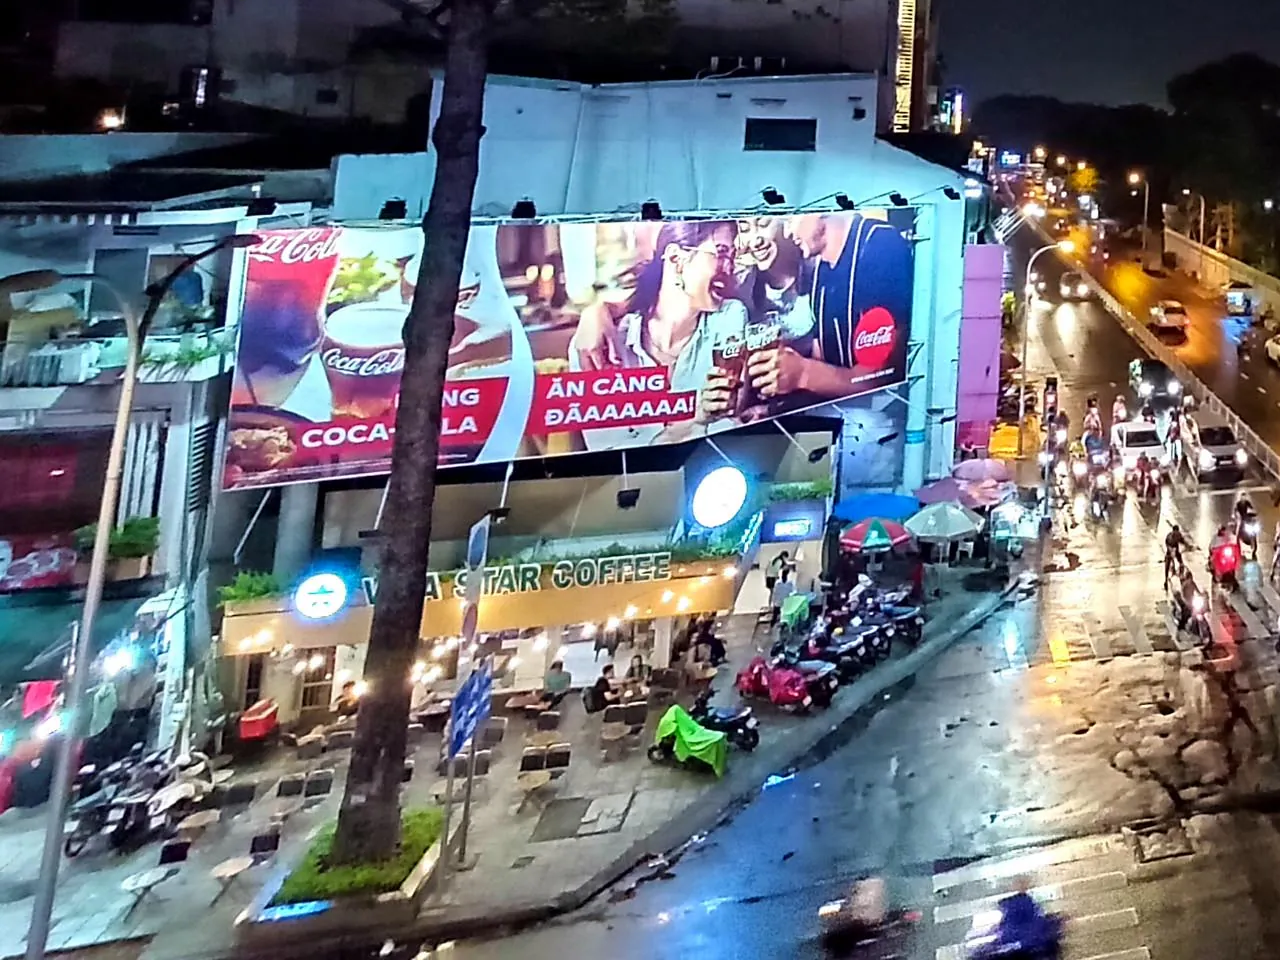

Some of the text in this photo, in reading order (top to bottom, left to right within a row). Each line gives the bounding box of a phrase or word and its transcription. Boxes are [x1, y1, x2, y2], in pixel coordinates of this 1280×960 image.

[546, 373, 665, 399] ĂN CÀNG
[552, 551, 672, 590] COFFEE
